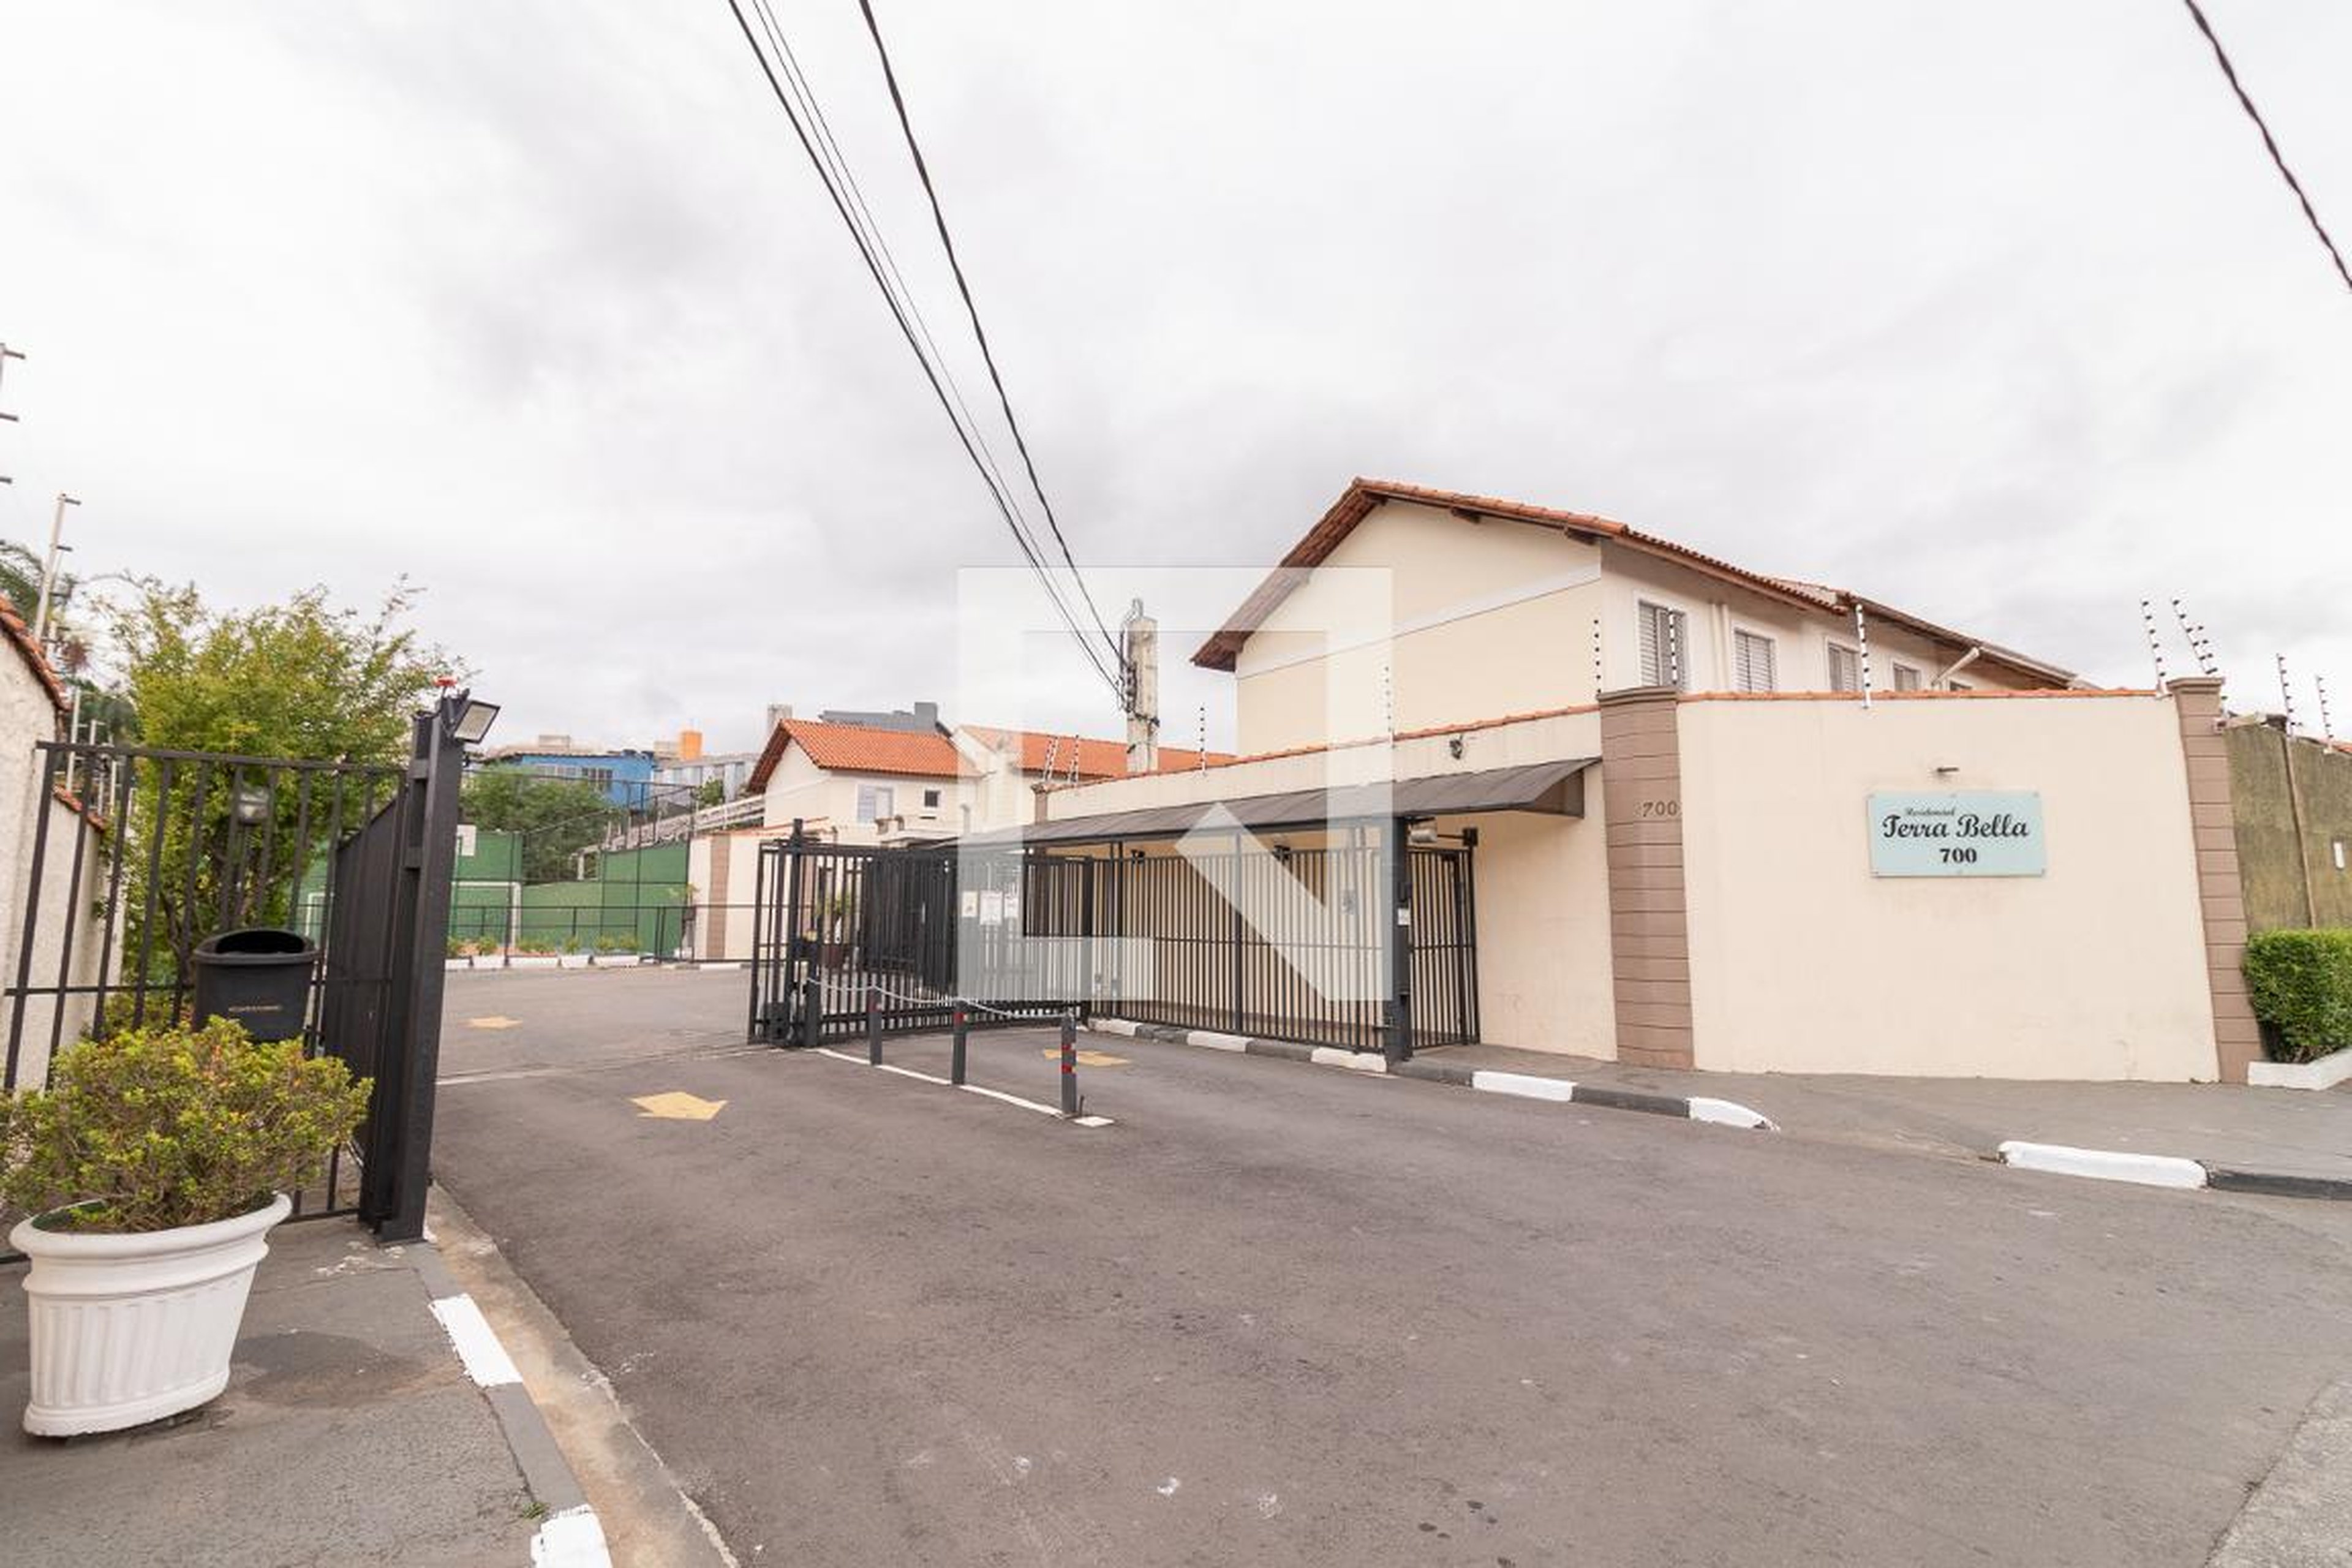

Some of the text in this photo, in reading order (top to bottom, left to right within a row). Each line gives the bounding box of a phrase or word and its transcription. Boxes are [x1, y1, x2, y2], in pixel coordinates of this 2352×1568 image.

[1643, 800, 1677, 817] 700
[1882, 813, 2029, 838] Terra Bella
[1940, 848, 1977, 864] 700
